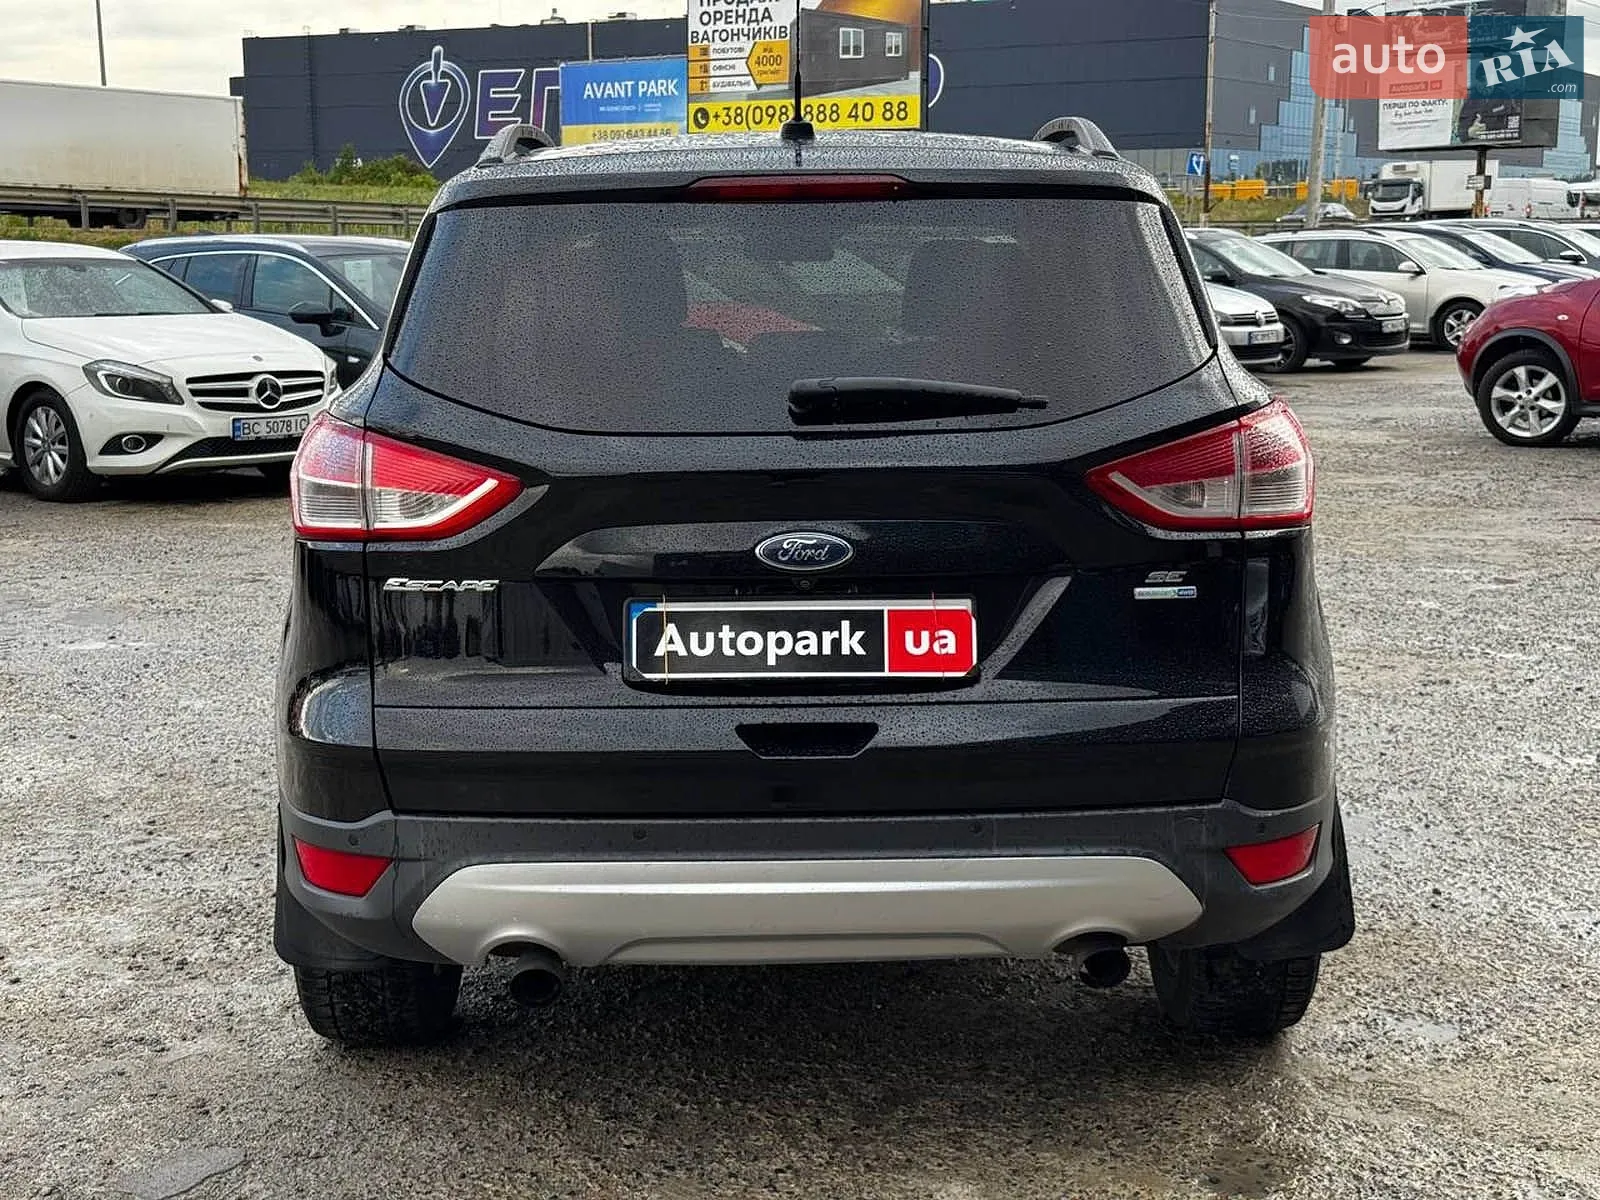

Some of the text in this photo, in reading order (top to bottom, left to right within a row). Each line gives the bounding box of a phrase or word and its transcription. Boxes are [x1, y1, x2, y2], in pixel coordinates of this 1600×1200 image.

[700, 7, 773, 26] ОРЕНДА
[690, 25, 788, 44] ВАГОНЧИКІВ
[755, 54, 782, 67] 4000
[583, 79, 679, 100] AVANT PARK
[803, 103, 840, 123] 888
[847, 102, 874, 122] 40
[882, 101, 908, 121] 88
[242, 422, 260, 436] BC
[265, 419, 292, 434] 5078
[777, 538, 830, 562] Ford
[383, 577, 499, 591] ESCAPE
[1144, 570, 1187, 583] SE
[654, 620, 956, 666] Autopark ua
